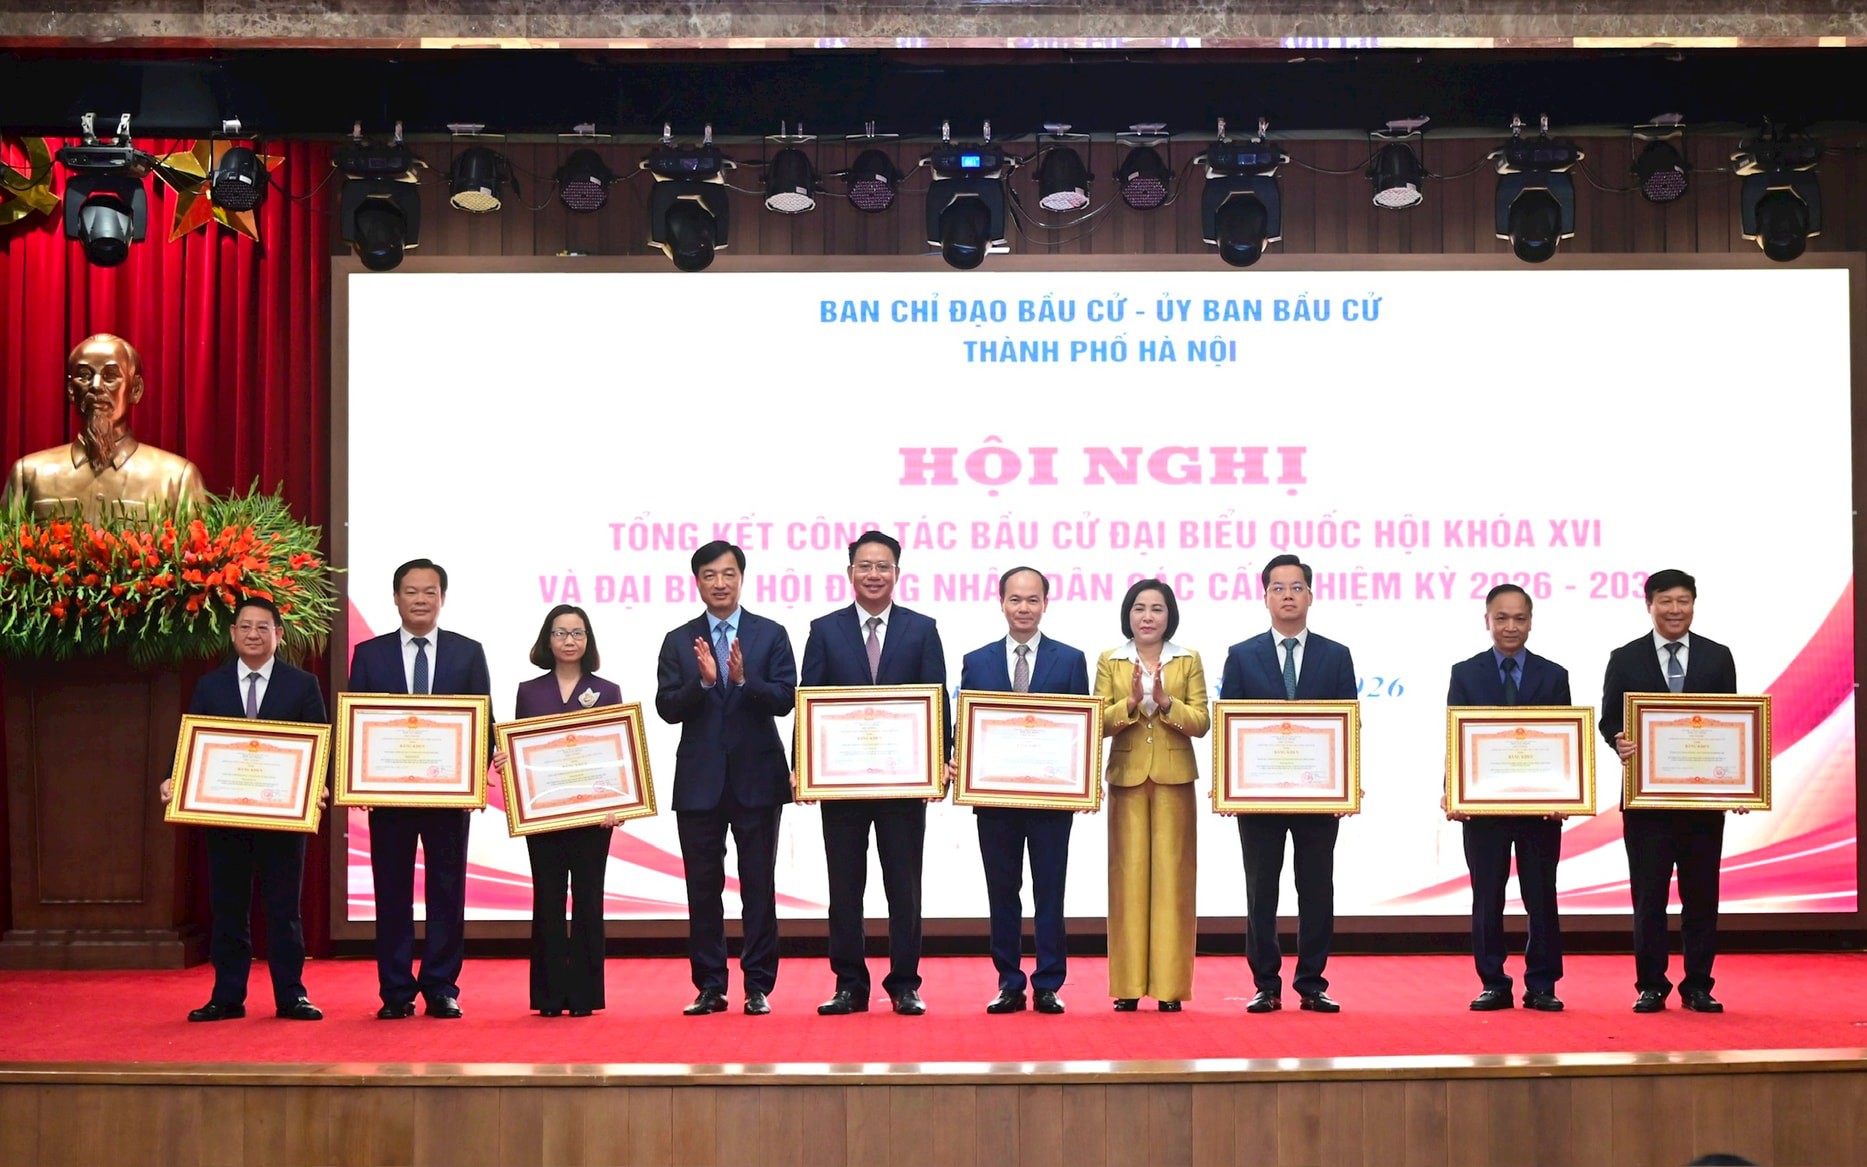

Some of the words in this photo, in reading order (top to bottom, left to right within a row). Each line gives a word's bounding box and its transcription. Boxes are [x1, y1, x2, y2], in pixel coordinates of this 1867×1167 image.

[820, 299, 881, 323] BAN
[891, 291, 940, 323] CHỈ
[947, 299, 1008, 328] ĐẠO
[1018, 291, 1077, 323] BẦU
[1087, 292, 1129, 322] CỬ
[1156, 292, 1192, 322] ỦY
[1203, 299, 1262, 322] BAN
[1273, 291, 1331, 322] BẦU
[1342, 292, 1383, 322] CỬ
[963, 334, 1060, 363] THÀNH
[1070, 331, 1128, 362] PHỐ
[1139, 335, 1177, 362] HÀ
[1187, 335, 1237, 367] NỘI
[898, 434, 1059, 497] HỘI
[1083, 446, 1308, 497] NGHỊ
[608, 511, 699, 551] TỔNG
[712, 513, 774, 551] KẾT
[893, 515, 957, 550] TÁC
[971, 511, 1039, 550] BẦU
[1052, 511, 1100, 549] CỬ
[1109, 520, 1166, 555] ĐẠI
[1179, 508, 1257, 549] BIỂU
[1270, 509, 1361, 552] QUỐC
[1375, 513, 1430, 555] HỘI
[1444, 513, 1536, 548] KHÓA
[1549, 519, 1601, 548] XVI
[539, 568, 582, 604] VÀ
[594, 574, 651, 610] ĐẠI
[665, 574, 698, 603] BI
[757, 568, 812, 609] HỘI
[825, 573, 920, 602] ĐG
[933, 566, 1001, 602] NHÂ
[1044, 566, 1113, 602] DÂN
[1315, 565, 1401, 607] HIỆM
[1415, 565, 1457, 600] KỲ
[1590, 571, 1650, 599] 203
[1357, 676, 1404, 697] 26
